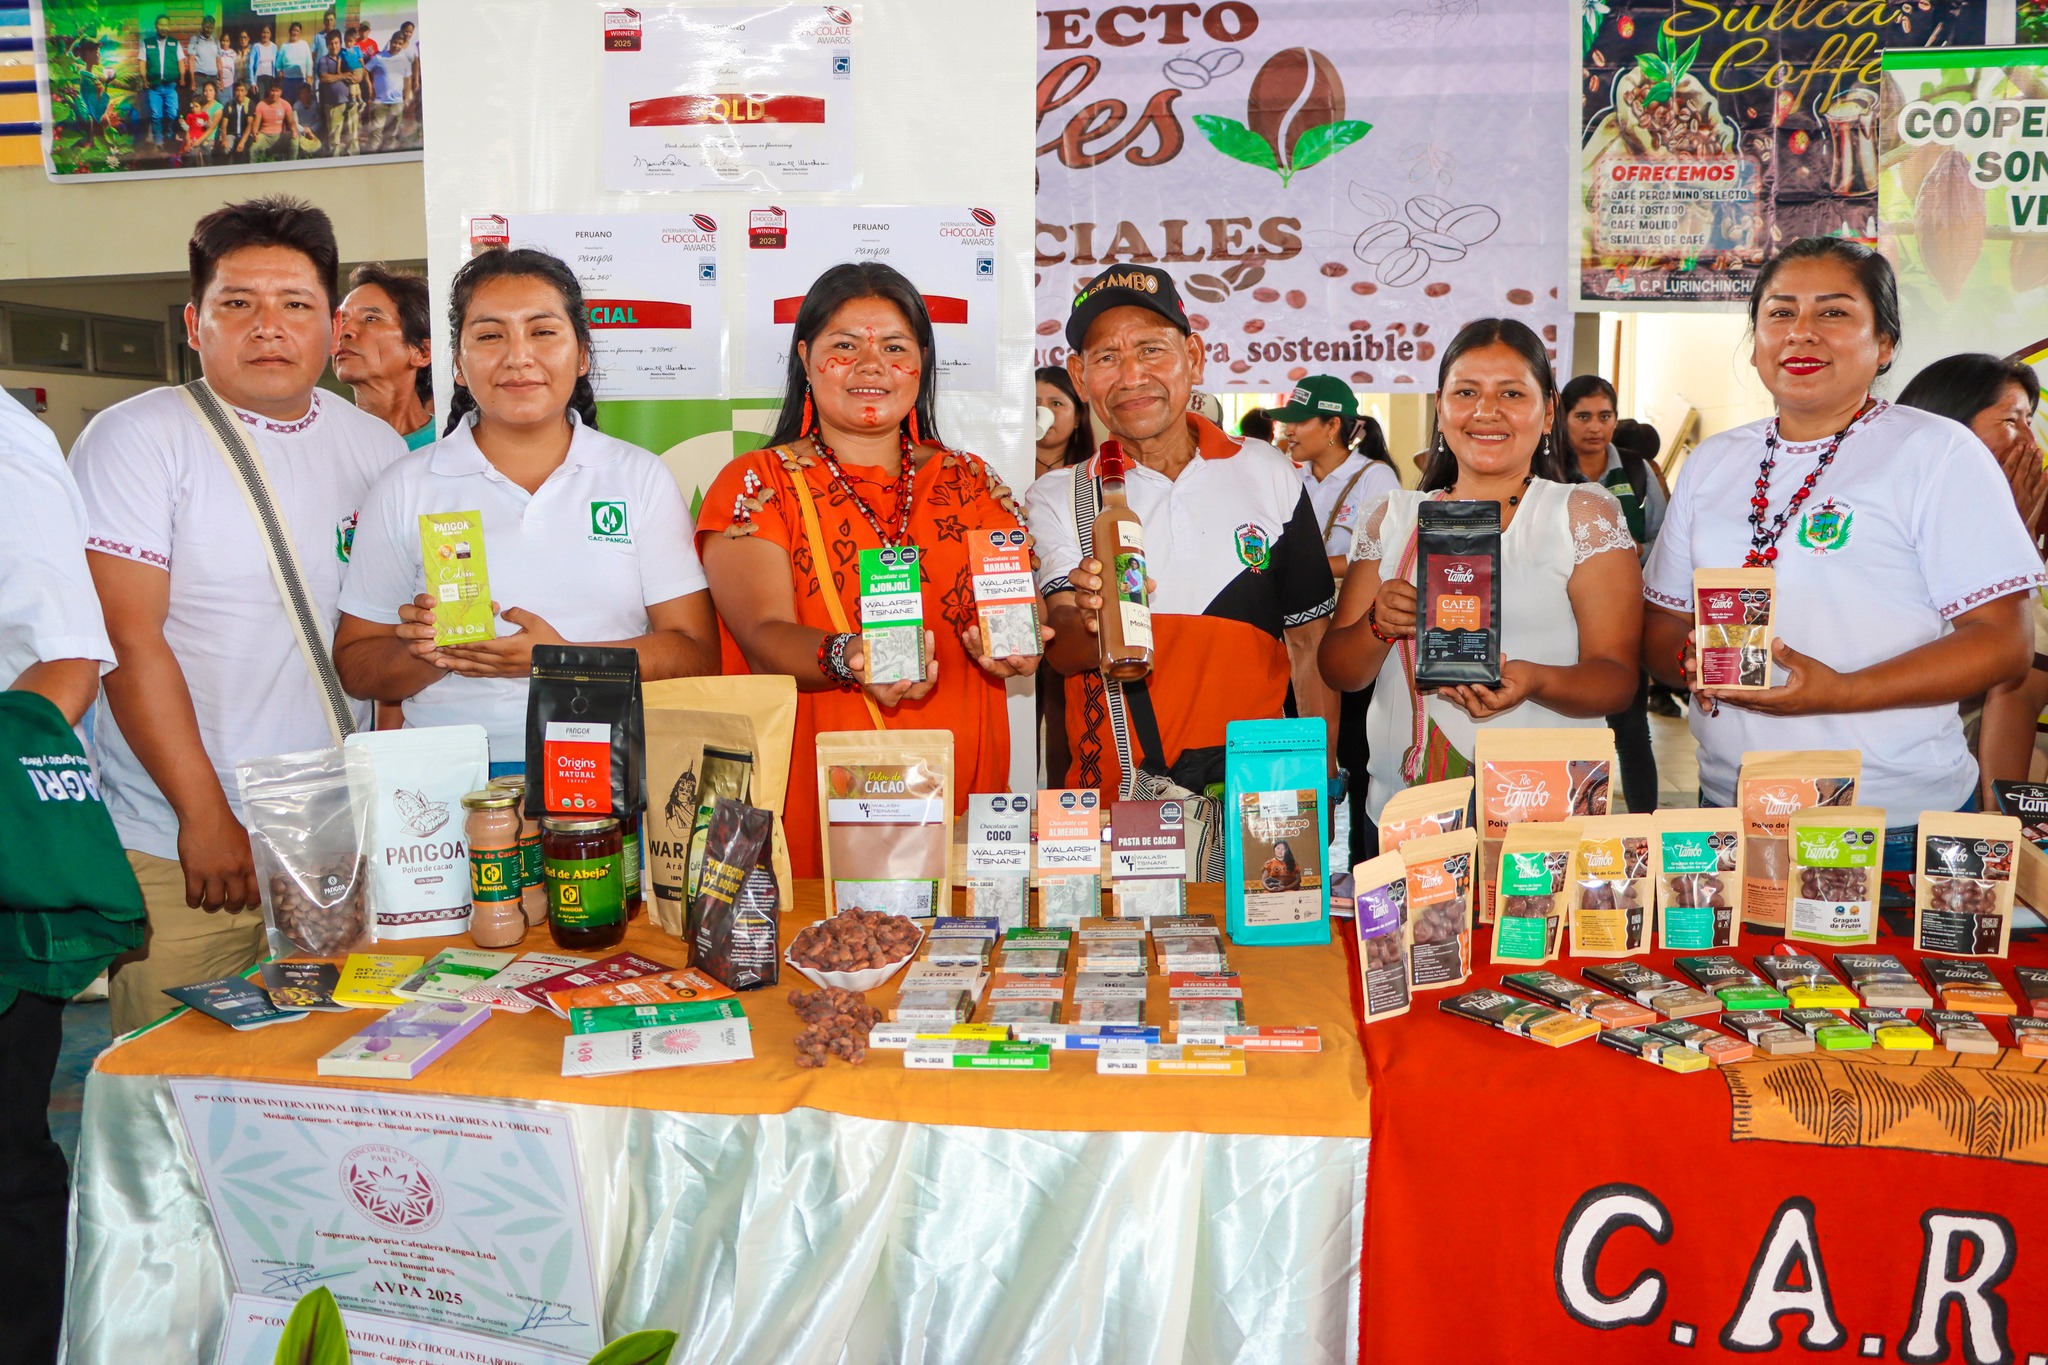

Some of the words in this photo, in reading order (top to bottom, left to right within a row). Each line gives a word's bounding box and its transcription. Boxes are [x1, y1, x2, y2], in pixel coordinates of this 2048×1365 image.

[1036, 1, 1259, 50] ECTO
[816, 36, 851, 44] AWARDS
[1905, 106, 2048, 139] COOPE
[1611, 165, 1735, 182] OFRECEMOS
[1611, 188, 1636, 200] CAFÉ
[1702, 191, 1747, 200] SELECTO
[1611, 204, 1636, 215] CAFÉ
[1639, 205, 1685, 215] TOSTADO
[853, 223, 890, 231] PERUANO
[1610, 219, 1635, 229] CAFÉ
[1639, 220, 1678, 230] MOLIDO
[939, 228, 994, 238] CHOCOLATE
[661, 234, 716, 244] CHOCOLATE
[759, 237, 777, 246] 2025
[961, 238, 995, 246] AWARDS
[1610, 235, 1661, 244] SEMILLAS
[1664, 235, 1677, 244] DE
[1680, 234, 1705, 244] CAFÉ
[683, 244, 717, 252] AWARDS
[1247, 333, 1415, 364] sostenible
[434, 521, 469, 532] PANGOA
[983, 562, 1021, 573] NARANJA
[898, 572, 909, 580] con
[870, 579, 911, 594] AJONJOLÍ
[979, 578, 1030, 587] WALARSH
[984, 586, 1028, 595] TSINANE
[864, 599, 918, 609] WALARSH
[1442, 597, 1475, 610] CAFÉ
[869, 607, 914, 617] TSINANE
[557, 756, 596, 770] Origins
[558, 770, 595, 778] NATURAL
[864, 780, 906, 794] CACAO
[2030, 788, 2044, 798] Rio
[986, 830, 1012, 841] COCO
[1118, 837, 1140, 846] PASTA
[1142, 836, 1152, 845] DE
[1153, 836, 1177, 845] CACAO
[1042, 846, 1097, 854] WALARSH
[485, 852, 495, 860] de
[402, 864, 422, 875] Polvo
[424, 864, 432, 872] de
[433, 863, 453, 871] cacao
[557, 869, 570, 880] de
[707, 857, 745, 881] PROTECTOR
[479, 884, 508, 892] PANGOA
[718, 877, 740, 894] BOSQUE
[1832, 917, 1860, 925] Grageas
[540, 956, 578, 964] PANGOA
[1950, 989, 2005, 997] NARANJA
[632, 1031, 643, 1061] FANTASÍA
[211, 1094, 267, 1106] CONCOURS
[268, 1099, 350, 1112] INTERNATIONAL
[350, 1105, 371, 1114] DES
[371, 1107, 433, 1121] CHOCOLATS
[435, 1113, 489, 1127] ELABORES
[490, 1120, 497, 1128] A
[500, 1121, 553, 1136] L'ORIGINE
[263, 1111, 296, 1121] Médaille
[378, 1122, 413, 1131] Chocolat
[433, 1127, 459, 1138] panela
[460, 1130, 493, 1140] fantaisie
[348, 1145, 391, 1161] CONCOURS
[371, 1154, 397, 1163] PARIS
[315, 1230, 366, 1242] Cooperativa
[367, 1235, 400, 1246] Agraria
[401, 1239, 444, 1252] Cafetalera
[445, 1245, 475, 1258] Pangoa
[476, 1250, 497, 1261] Ltda
[383, 1248, 409, 1258] Camu
[410, 1252, 435, 1262] Camu
[367, 1257, 388, 1266] Love
[399, 1261, 435, 1273] Inmortal
[436, 1266, 456, 1276] 68%
[372, 1280, 423, 1298] AVPA
[425, 1288, 464, 1306] 2025
[333, 1293, 359, 1303] Agence
[387, 1300, 430, 1312] Valorisation
[430, 1306, 444, 1314] des
[445, 1309, 474, 1320] Produits
[476, 1317, 509, 1328] Agricoles
[399, 1338, 416, 1349] DES
[418, 1342, 475, 1360] CHOCOLATS
